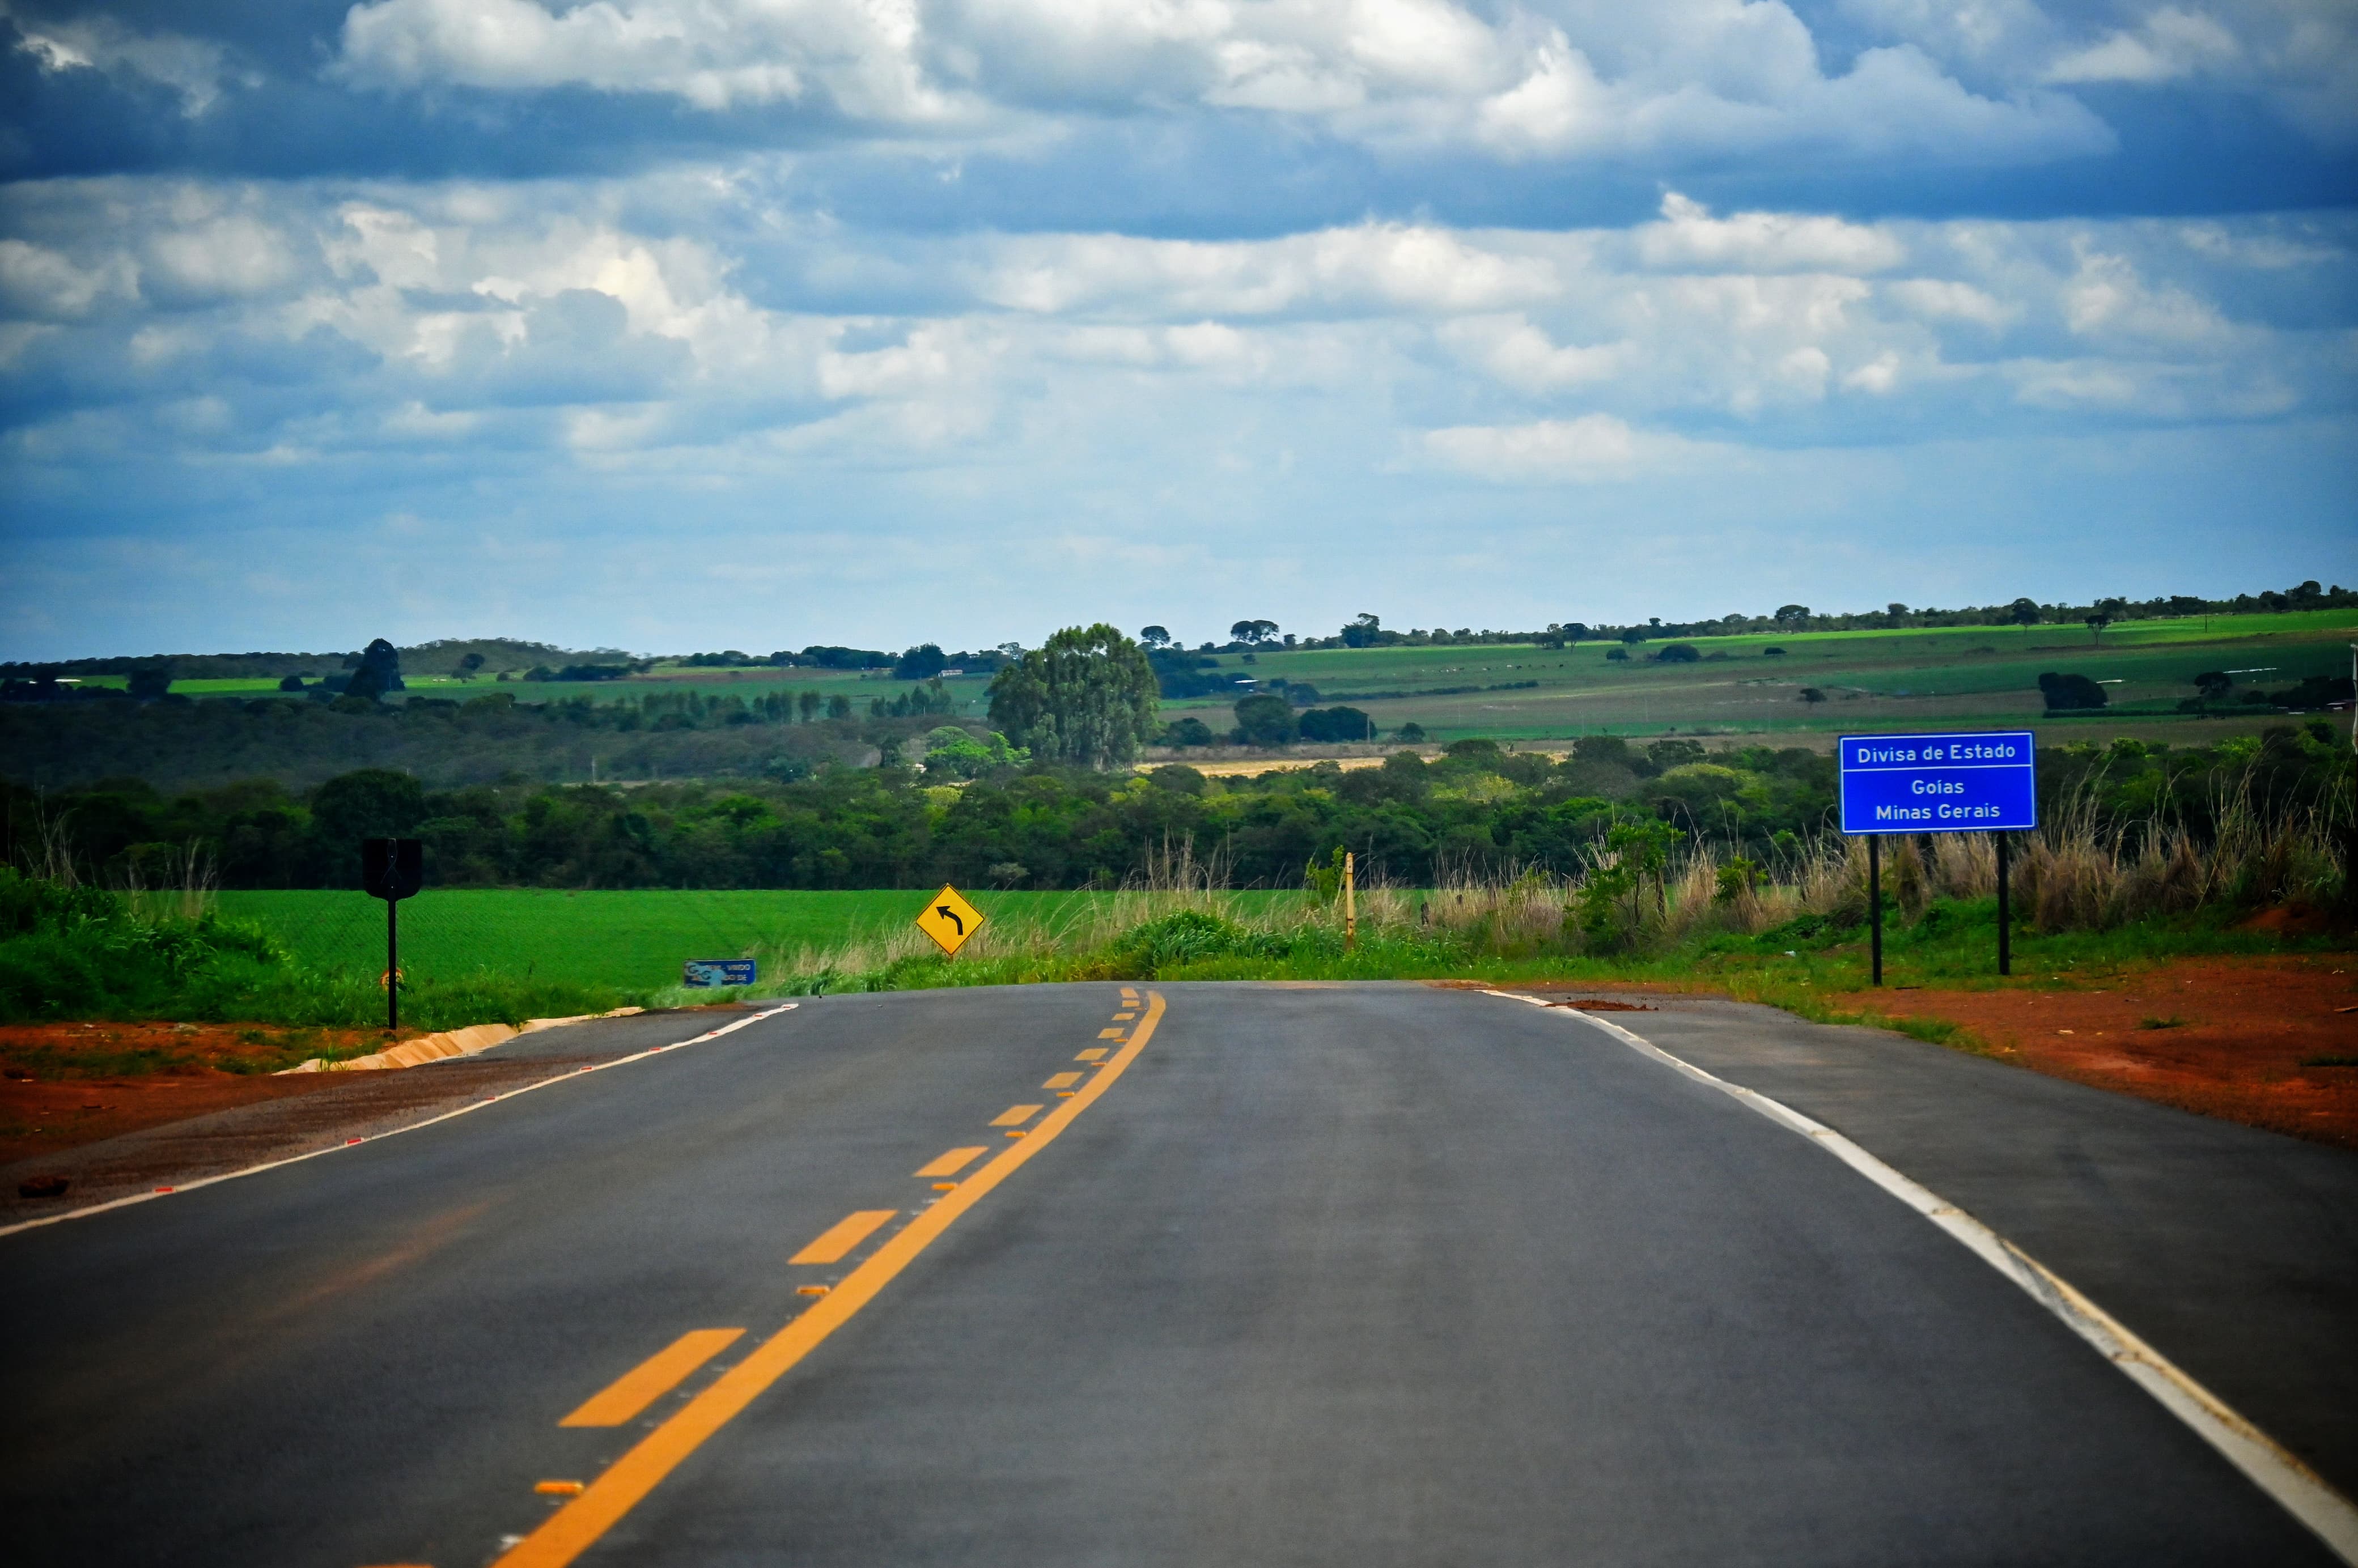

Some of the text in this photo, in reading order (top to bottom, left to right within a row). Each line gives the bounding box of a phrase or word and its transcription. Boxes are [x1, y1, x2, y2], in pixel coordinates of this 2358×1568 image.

[1857, 743, 2016, 763] Divisa de Estado
[1912, 780, 1965, 794] Goías
[1876, 802, 2000, 820] Minas Gerais
